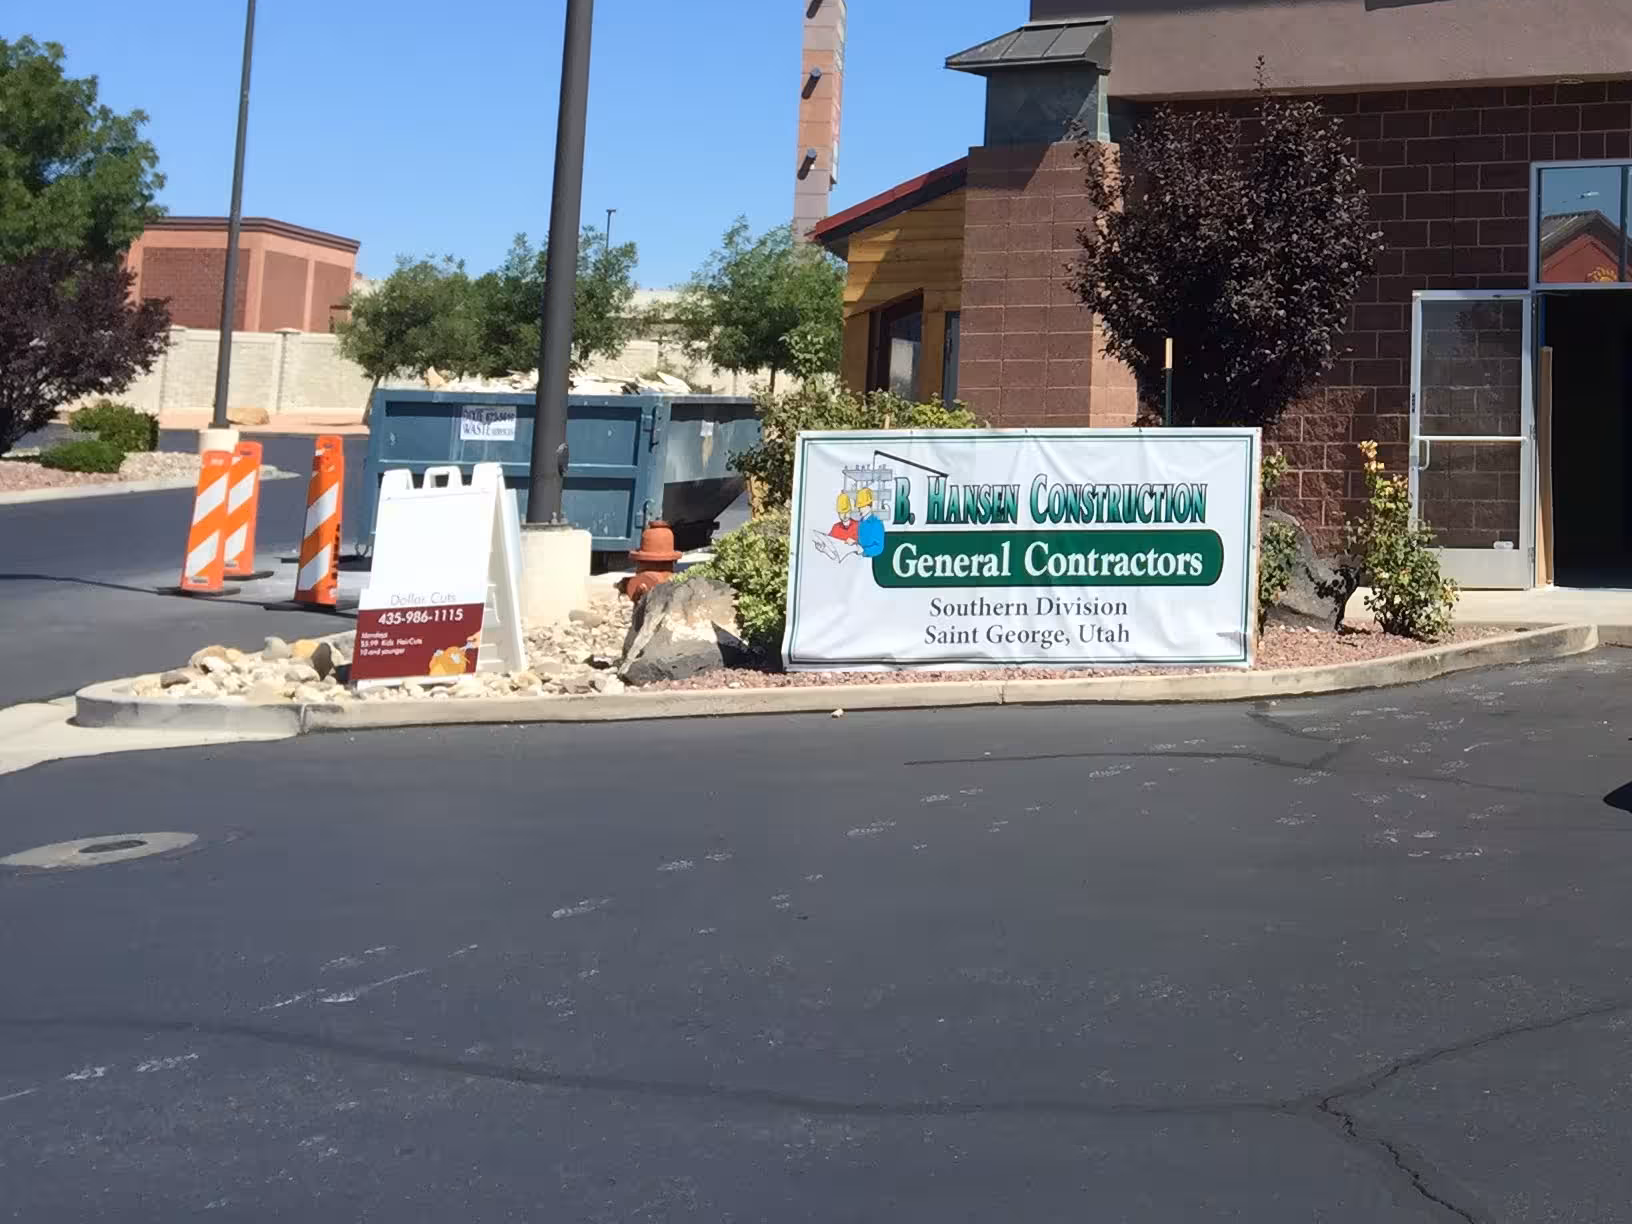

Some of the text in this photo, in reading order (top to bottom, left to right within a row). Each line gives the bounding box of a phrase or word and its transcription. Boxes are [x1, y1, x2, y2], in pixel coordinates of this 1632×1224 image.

[893, 473, 1208, 526] B. HANSEN CONSTRUCTION
[892, 540, 1204, 578] General Contractors
[390, 592, 456, 605] Dollar Cuts
[929, 594, 1128, 617] Southern Division
[378, 608, 464, 625] 435-986-1115
[924, 623, 1130, 649] Saint George, Utah
